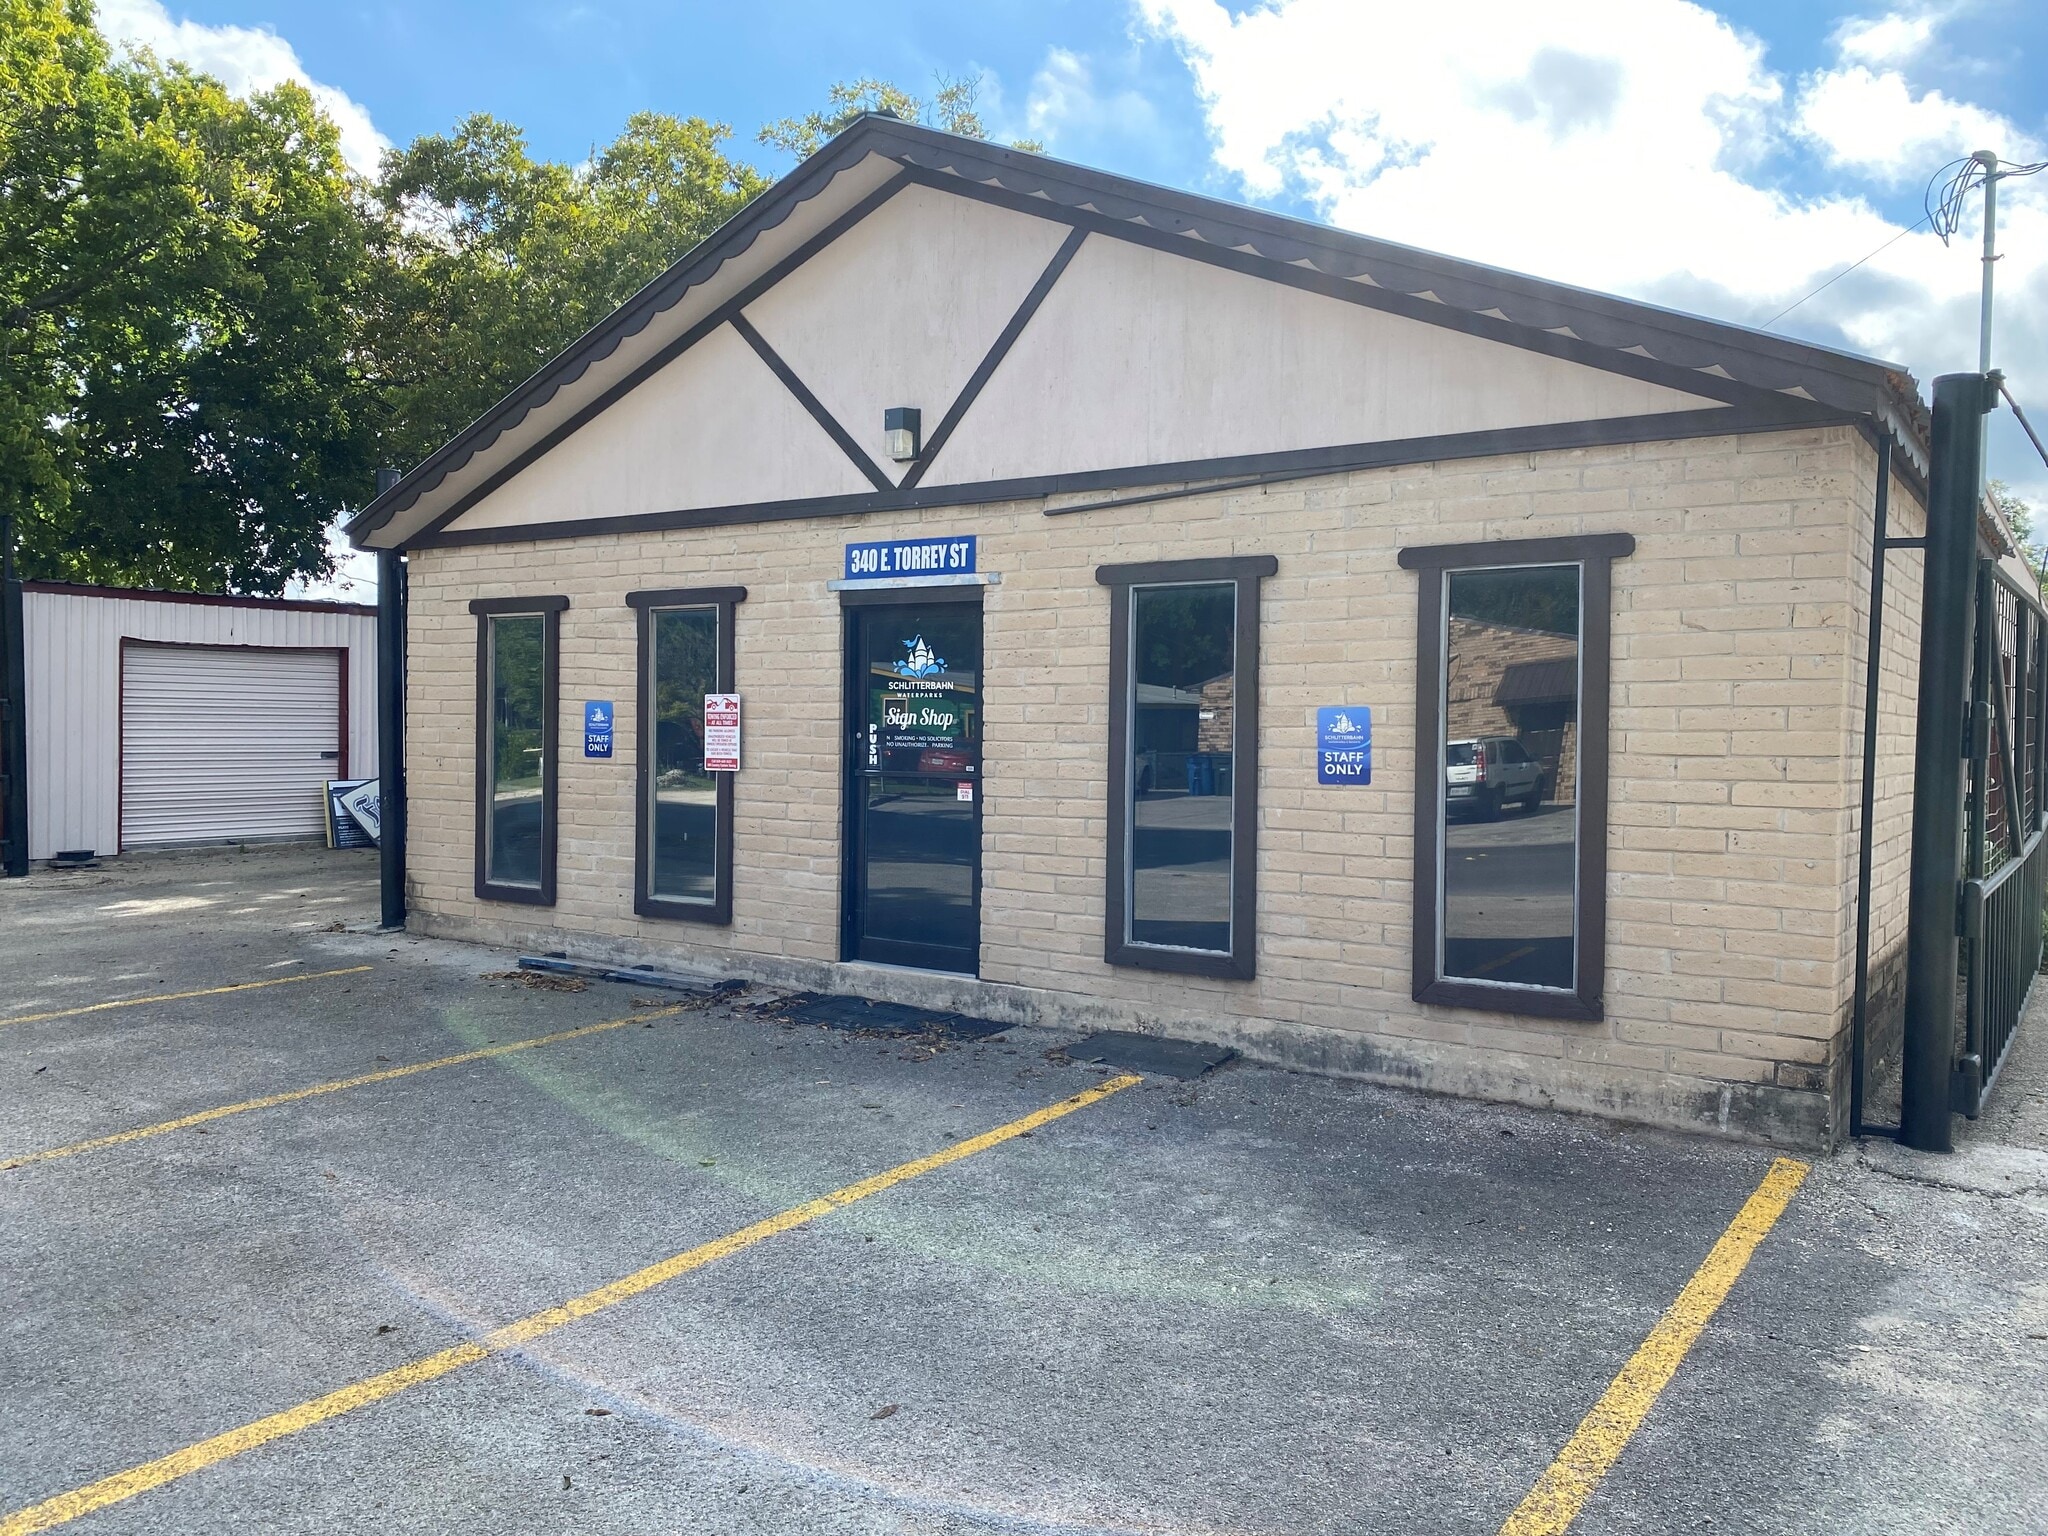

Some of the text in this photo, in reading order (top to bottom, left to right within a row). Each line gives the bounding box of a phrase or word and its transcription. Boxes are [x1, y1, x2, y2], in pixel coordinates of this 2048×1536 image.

[851, 543, 969, 574] 340 E. TORREY ST
[888, 681, 954, 690] SCHLITTERBAHN
[886, 707, 954, 731] Sign Shop
[588, 734, 609, 743] STAFF
[868, 724, 878, 765] PUSH
[588, 743, 608, 752] ONLY
[1325, 751, 1364, 763] STAFF
[1324, 763, 1363, 775] ONLY
